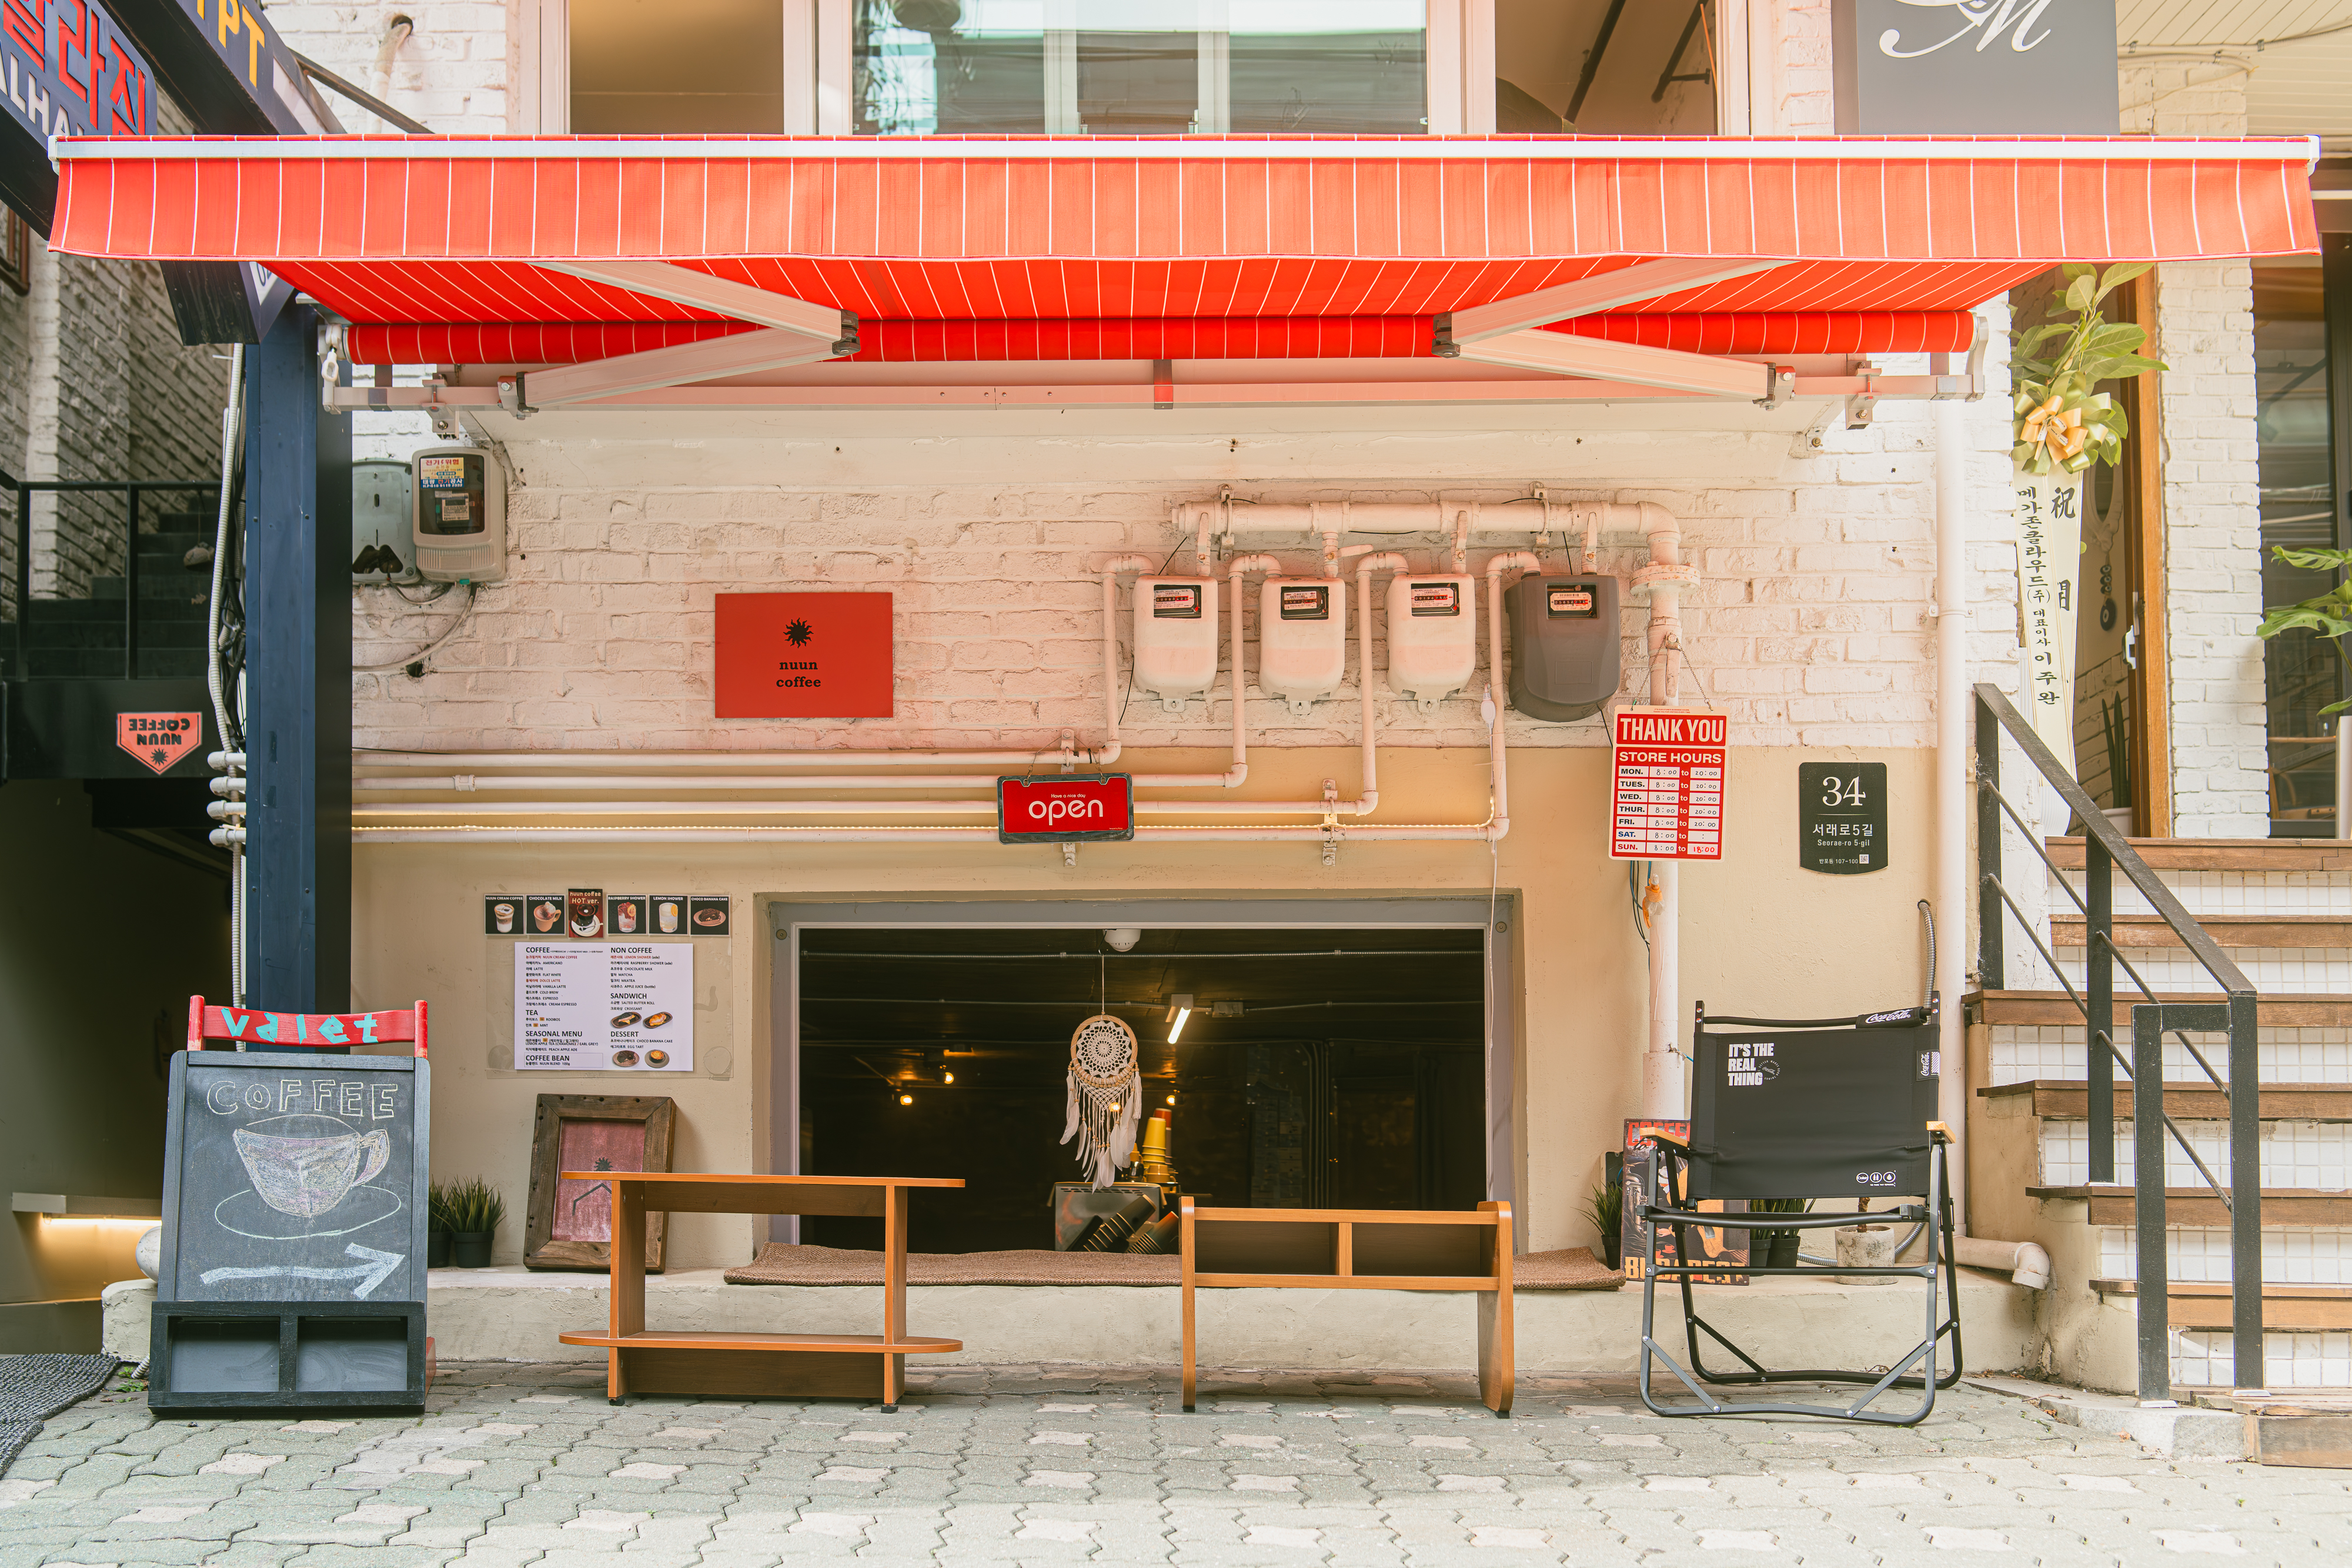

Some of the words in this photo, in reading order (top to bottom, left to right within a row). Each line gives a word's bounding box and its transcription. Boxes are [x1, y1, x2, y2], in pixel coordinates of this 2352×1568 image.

[197, 0, 265, 88] PT
[0, 40, 85, 135] LHA
[2051, 487, 2076, 519] 祝
[2033, 609, 2050, 647] 대표이사
[779, 661, 818, 670] nuun
[776, 676, 821, 687] coffee
[2034, 652, 2060, 704] 이주완
[129, 718, 190, 731] COFFEE
[1620, 718, 1683, 741] THANK
[1686, 719, 1723, 742] YOU
[137, 733, 182, 745] NUUN
[1619, 752, 1666, 763] STORE
[1671, 753, 1722, 763] HOURS
[1822, 776, 1866, 806] 34
[1028, 800, 1103, 826] open
[1812, 824, 1873, 837] 서래로5길
[1854, 839, 1870, 847] 5-gil
[1729, 1044, 1751, 1057] IT'S
[1752, 1042, 1775, 1057] THE
[1728, 1058, 1756, 1071] REAL
[1728, 1072, 1763, 1086] THING
[206, 1079, 398, 1121] COFFEE
